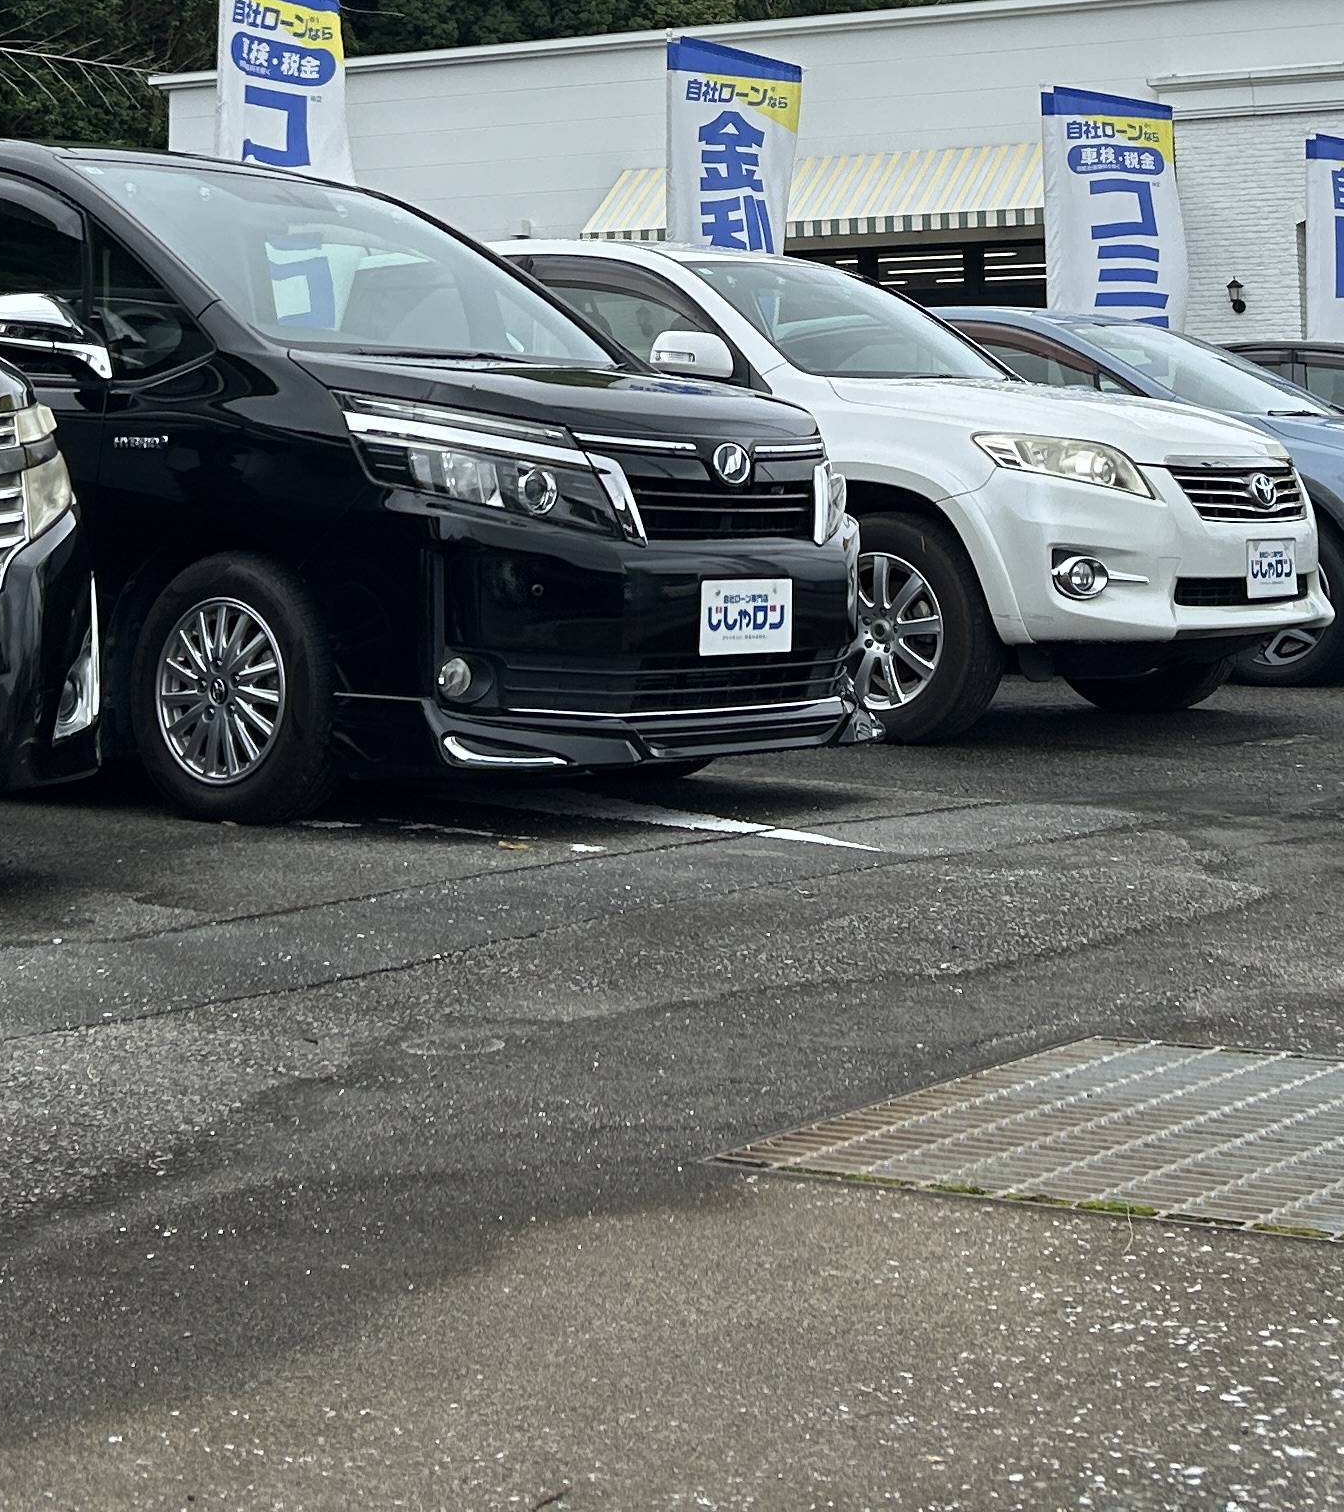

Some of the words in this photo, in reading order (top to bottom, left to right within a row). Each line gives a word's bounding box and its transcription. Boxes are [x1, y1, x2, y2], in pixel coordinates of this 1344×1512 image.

[685, 79, 788, 109] 自社ローンなら
[1066, 120, 1160, 143] 自社ローンなら
[1080, 146, 1156, 170] 車検・税金
